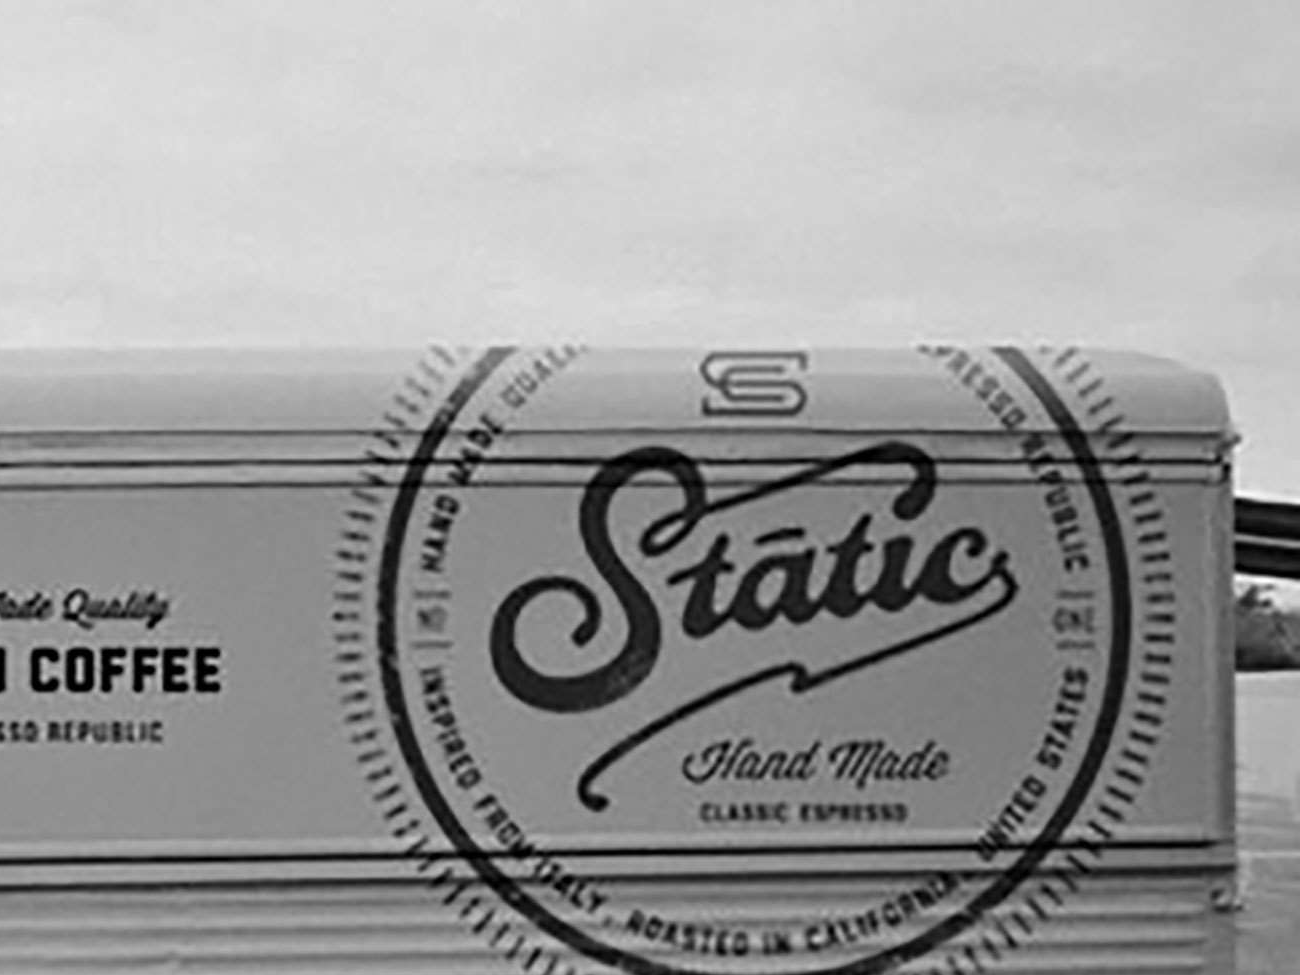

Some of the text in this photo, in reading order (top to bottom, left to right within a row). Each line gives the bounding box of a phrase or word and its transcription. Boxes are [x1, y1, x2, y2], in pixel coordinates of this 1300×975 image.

[421, 495, 461, 572] HAND
[448, 414, 504, 486] MADE
[62, 588, 170, 630] Quality
[30, 647, 221, 693] COFFEE
[47, 721, 164, 743] REPUBLIC
[681, 738, 952, 791] Hand Made
[420, 665, 483, 790] INSPIRED
[624, 909, 751, 957] ROASTED
[760, 929, 794, 955] IN
[974, 774, 1048, 862] UNITED
[1036, 666, 1090, 771] STATES
